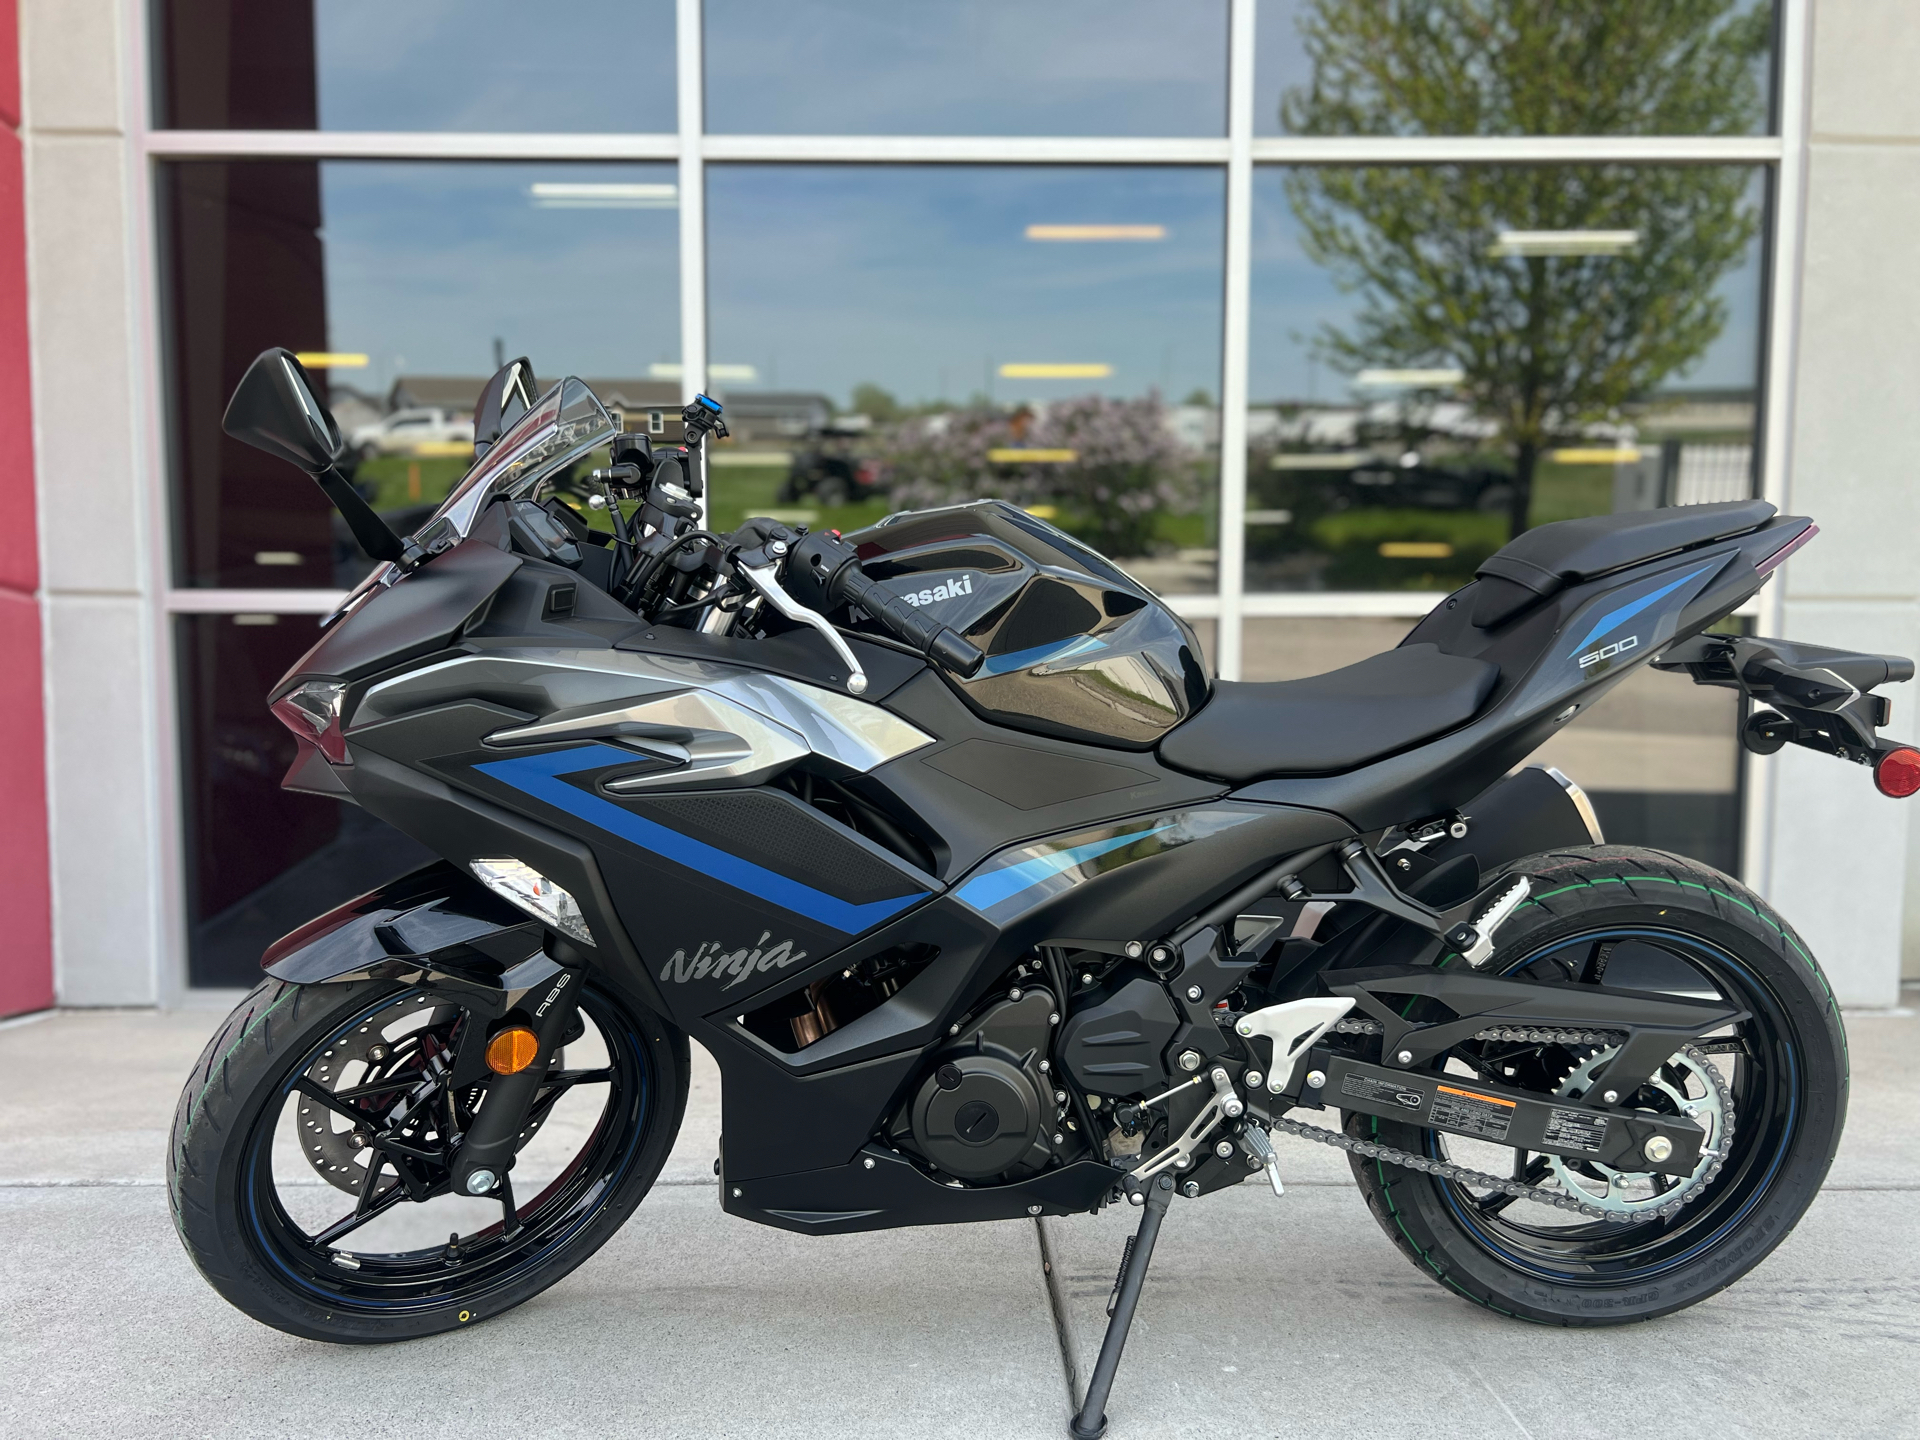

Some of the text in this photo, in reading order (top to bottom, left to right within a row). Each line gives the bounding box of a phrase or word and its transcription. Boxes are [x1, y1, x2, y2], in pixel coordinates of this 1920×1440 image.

[1578, 635, 1638, 669] 500
[659, 931, 807, 992] Ninja
[535, 973, 571, 1017] ABS
[1581, 1214, 1776, 1309] SPORTMAX GPR-300
